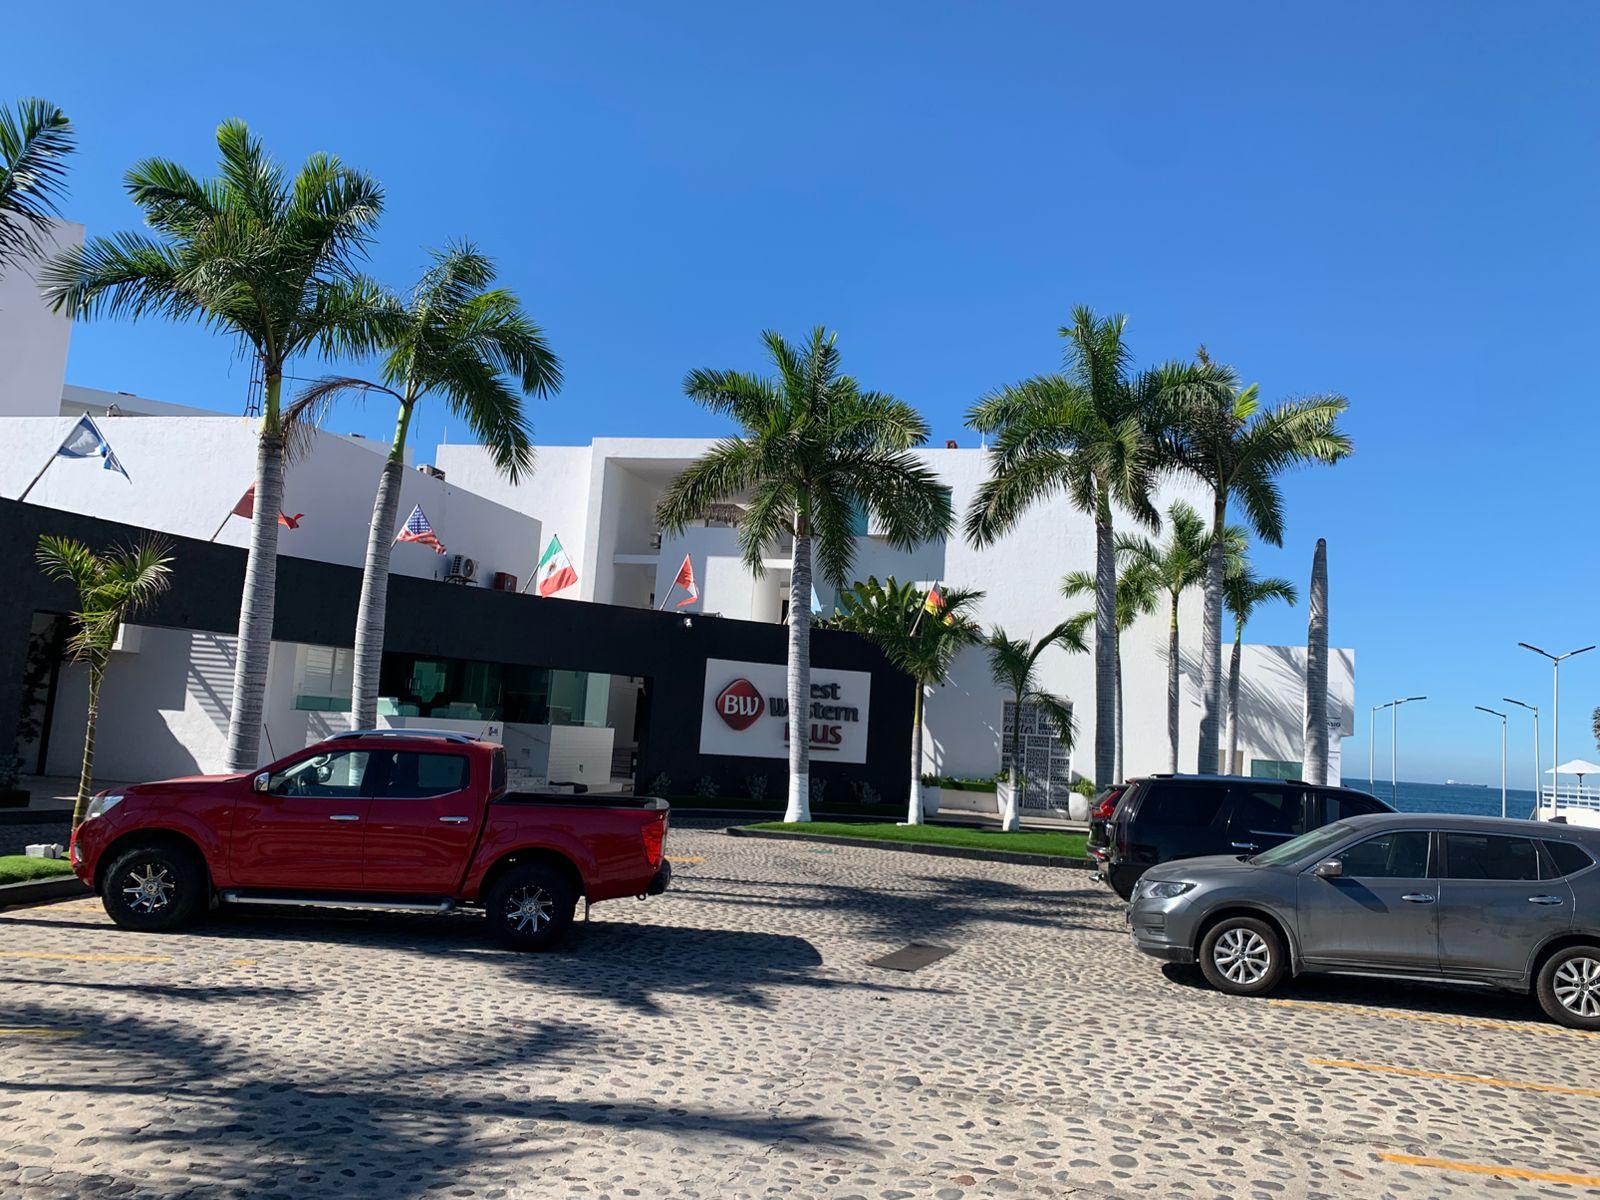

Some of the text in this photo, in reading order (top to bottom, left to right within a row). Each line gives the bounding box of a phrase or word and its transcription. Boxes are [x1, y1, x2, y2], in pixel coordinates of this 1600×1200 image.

[809, 683, 841, 700] est
[724, 694, 760, 716] BW
[769, 696, 859, 722] Wtern
